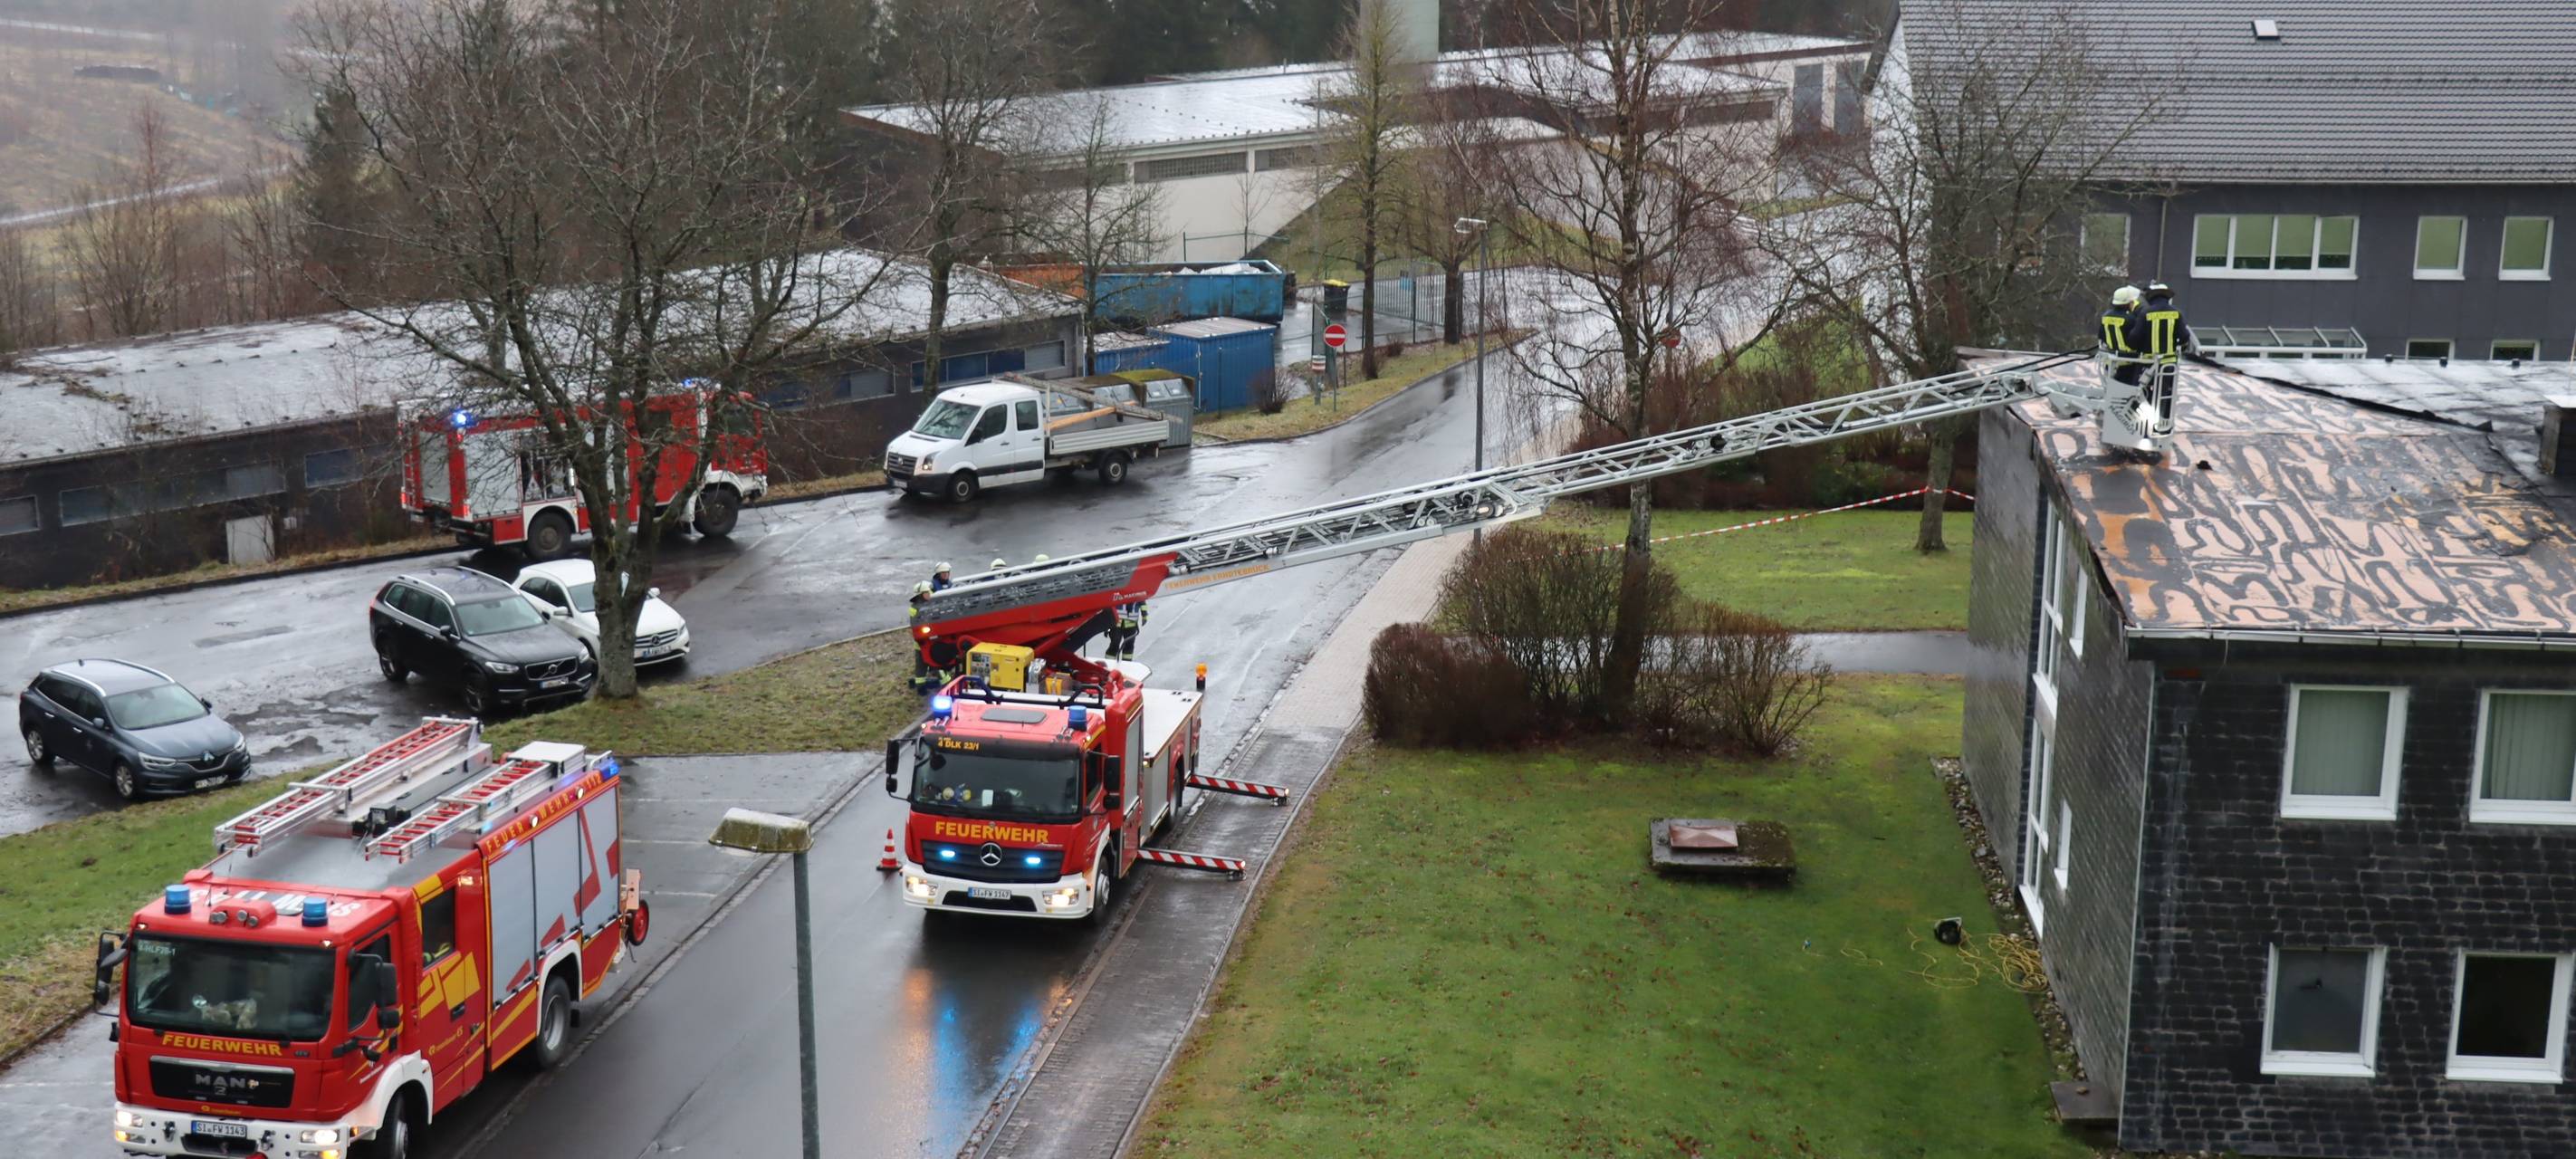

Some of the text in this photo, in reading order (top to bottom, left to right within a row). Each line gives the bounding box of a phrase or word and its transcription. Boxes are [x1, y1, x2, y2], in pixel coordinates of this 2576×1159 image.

[935, 821, 1049, 843] FEUERWEHR
[161, 1034, 282, 1057] FEUERWEHR
[195, 1074, 246, 1088] MAN
